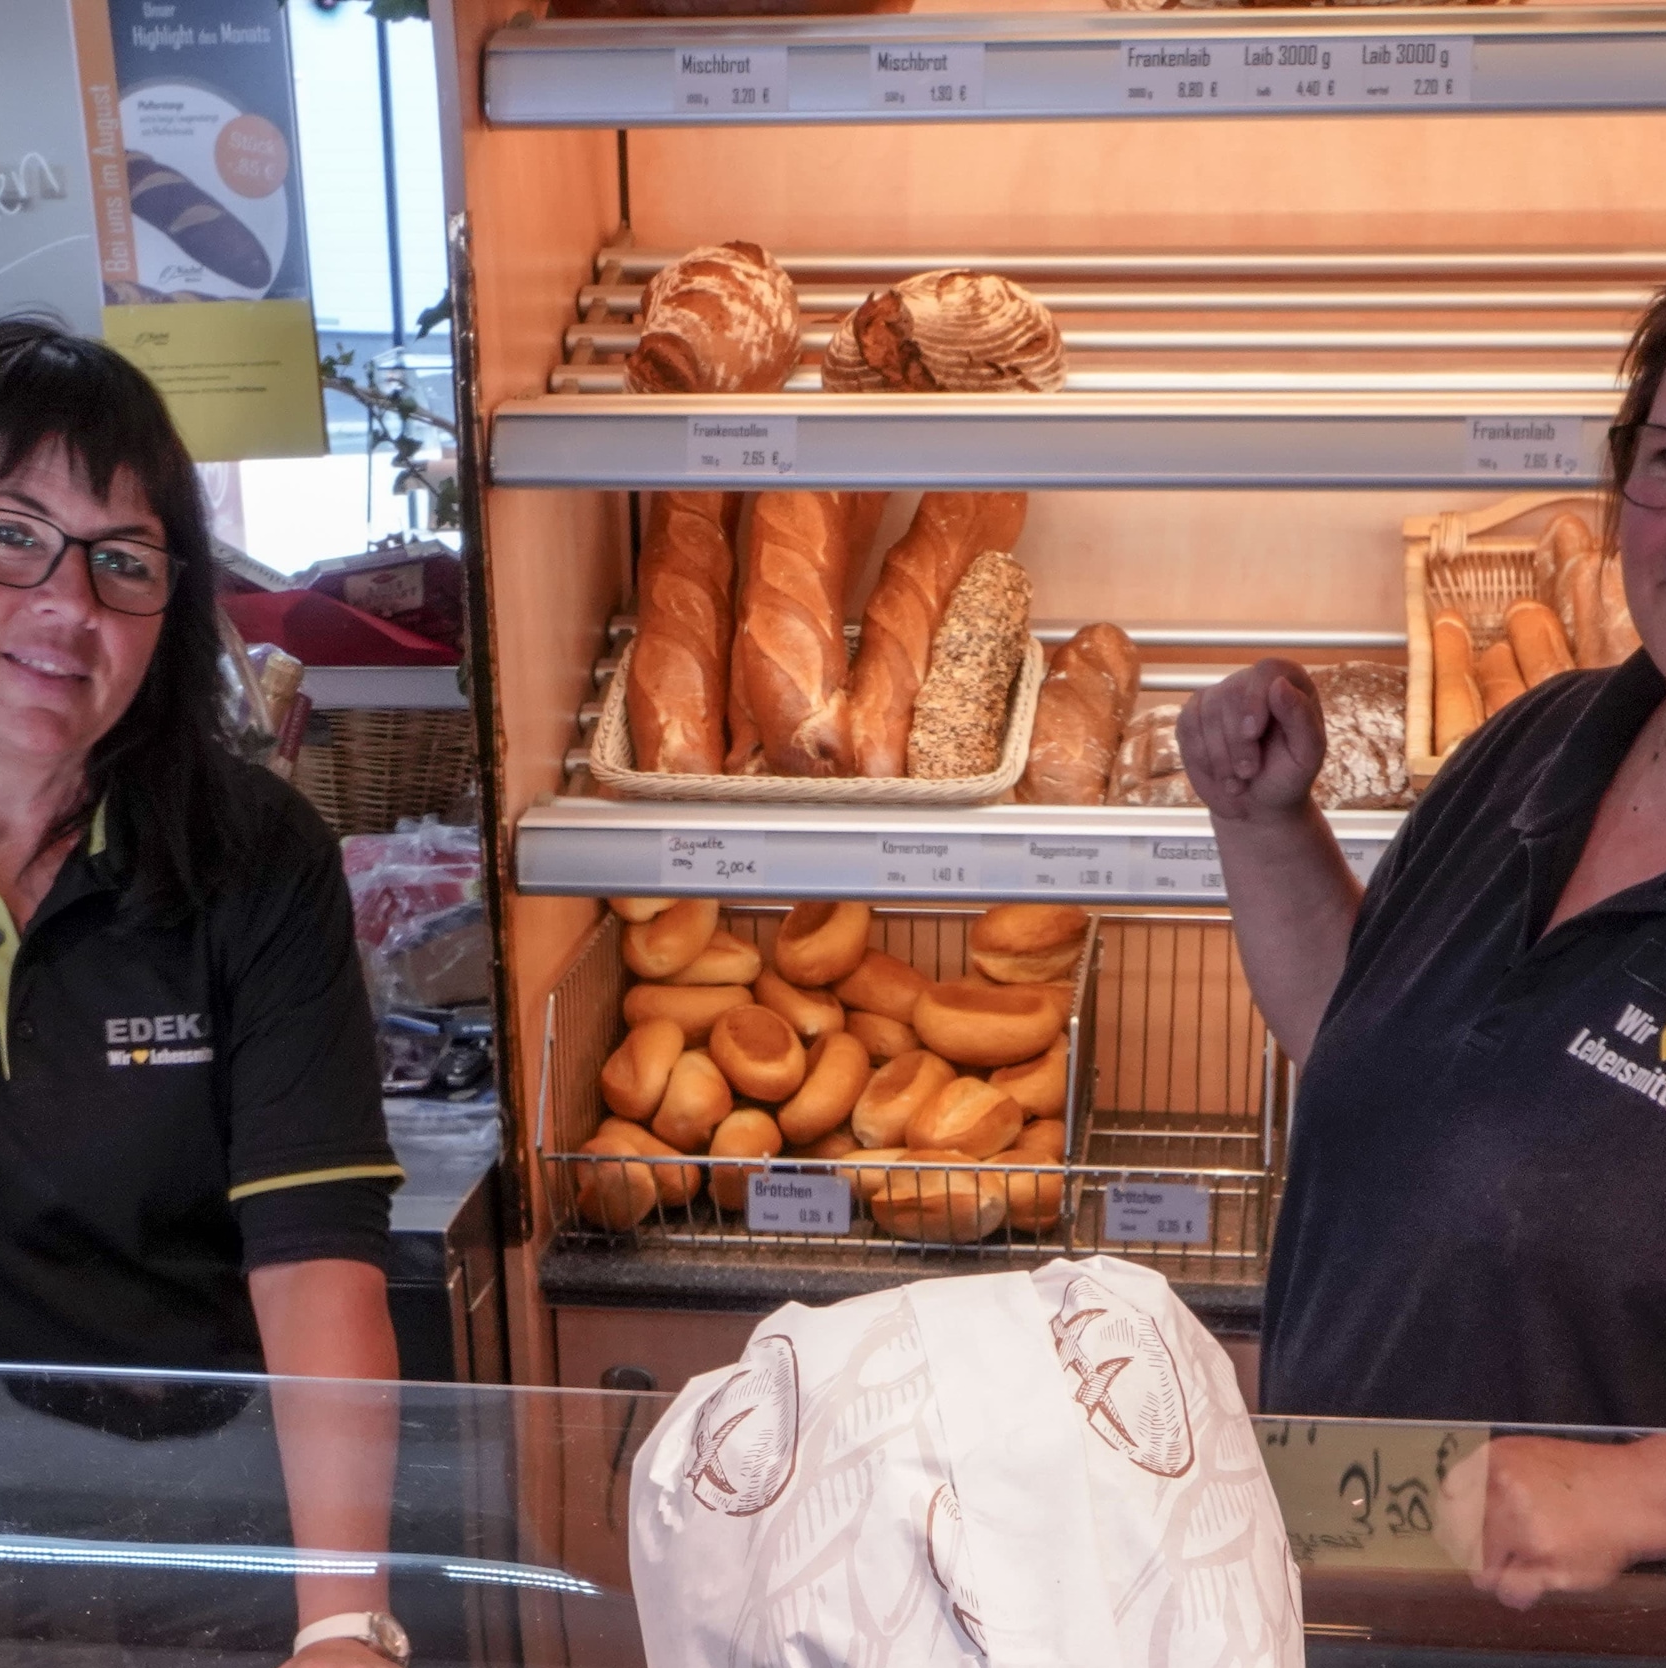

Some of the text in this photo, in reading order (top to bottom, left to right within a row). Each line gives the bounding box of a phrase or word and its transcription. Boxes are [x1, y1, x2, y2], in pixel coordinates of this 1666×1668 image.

[133, 23, 271, 51] Highlight des Monats
[682, 53, 751, 75] Mischbrot
[877, 52, 948, 72] Mischbrot
[1128, 47, 1211, 68] Frankenlaib
[1244, 45, 1331, 70] Laib 3000 g
[1362, 43, 1450, 68] Laib 3000 g
[89, 84, 131, 273] Bei uns im August
[693, 423, 768, 438] Frankenstollen
[1472, 421, 1556, 440] Frankenlaib
[669, 837, 725, 855] Baguette
[105, 1013, 203, 1044] EDEK
[1614, 1003, 1660, 1044] Wir
